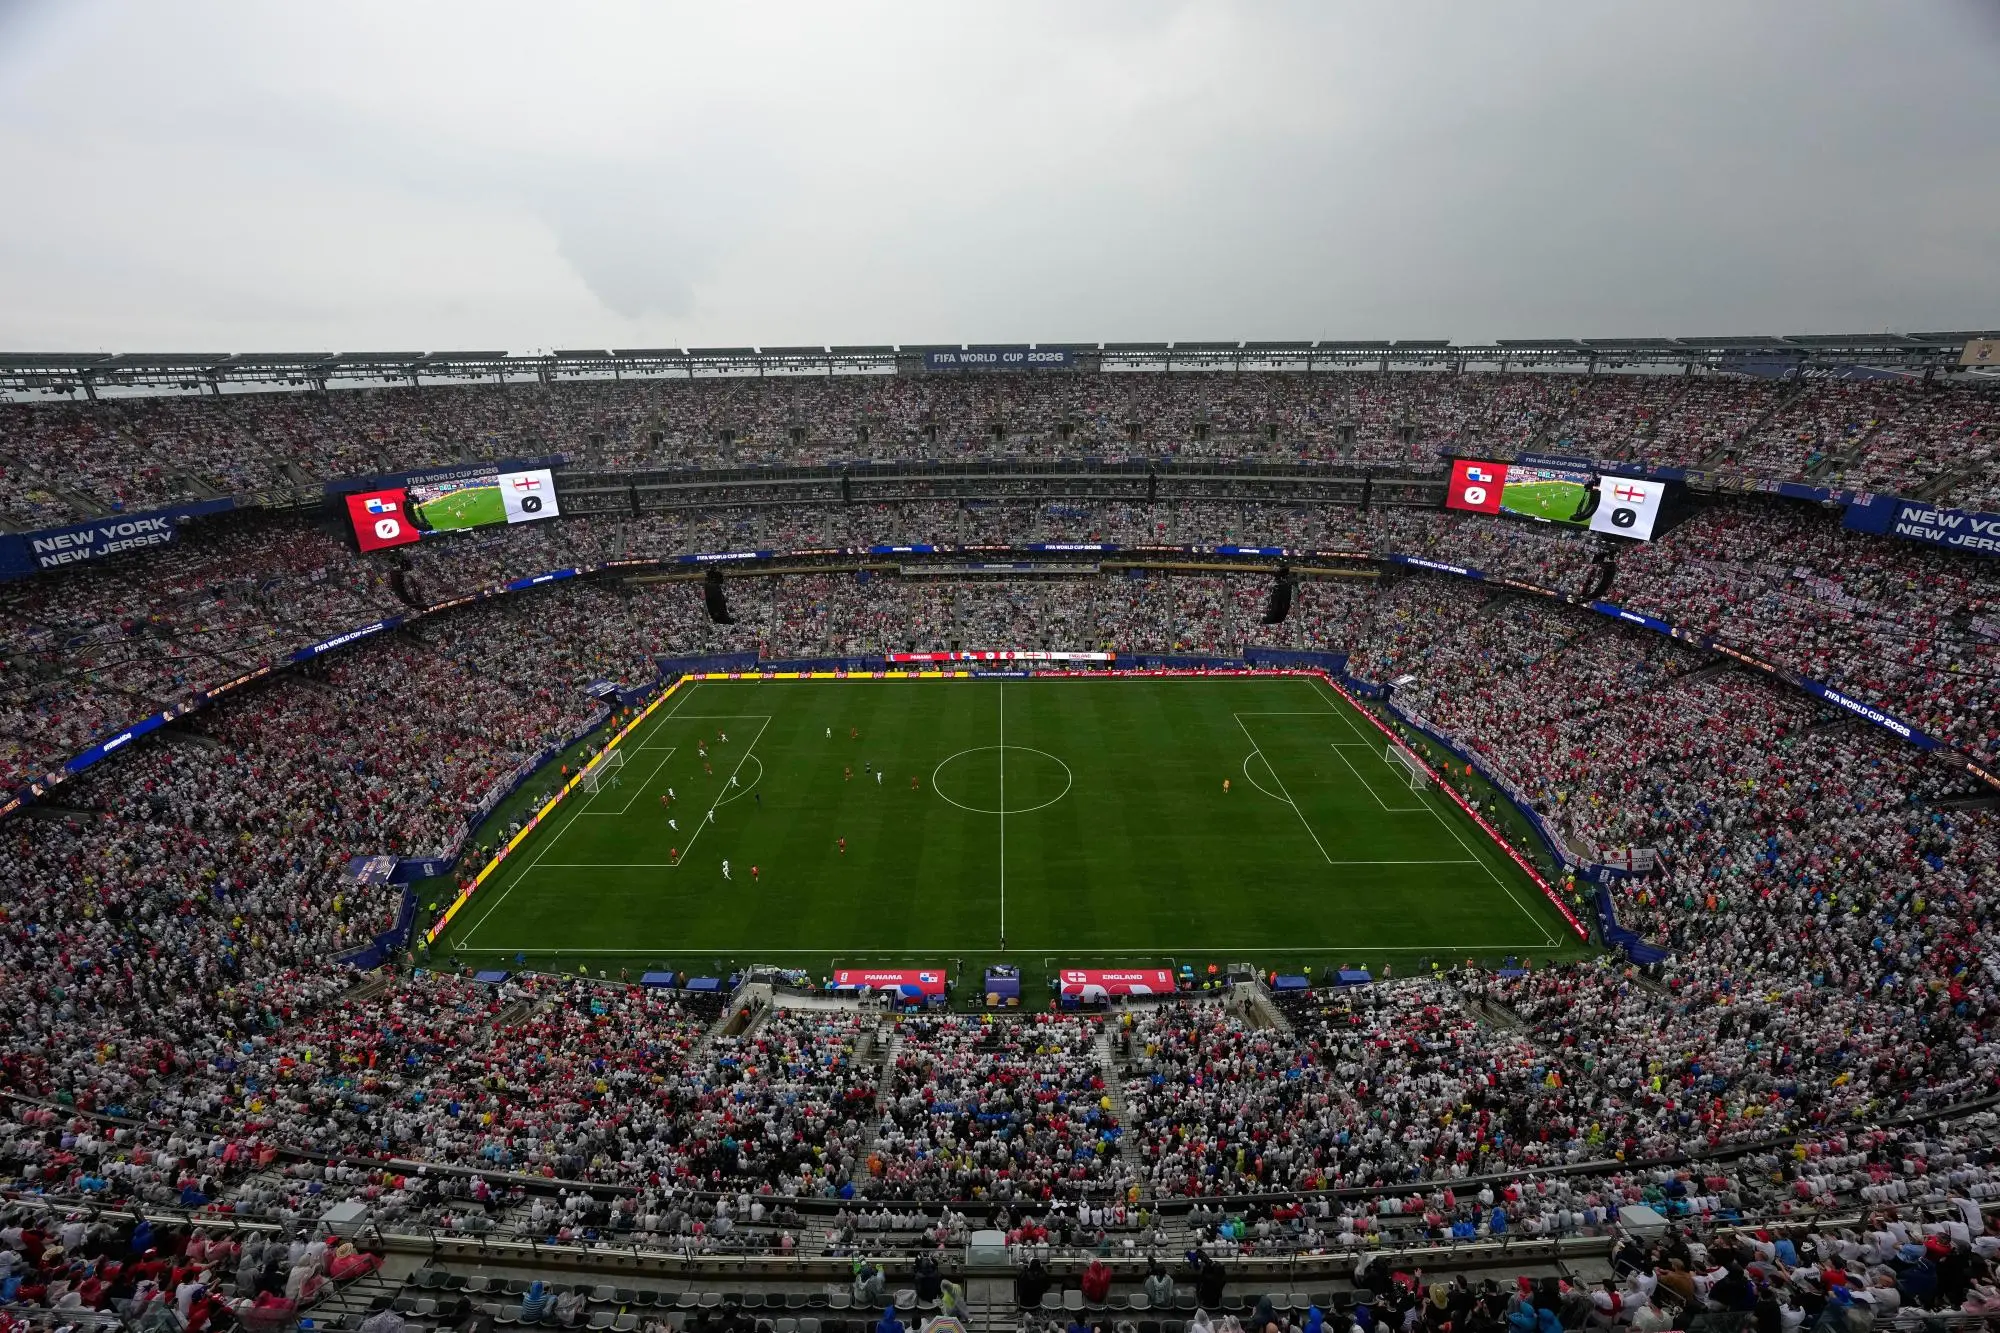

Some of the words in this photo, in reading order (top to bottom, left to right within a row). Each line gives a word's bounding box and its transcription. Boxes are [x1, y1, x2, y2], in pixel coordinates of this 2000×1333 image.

[934, 353, 956, 362] FIFA
[960, 353, 997, 362] WORLD
[1003, 353, 1023, 362] CUP
[1027, 352, 1064, 362] 2026
[406, 476, 425, 485] FIFA
[425, 473, 455, 482] WORLD
[456, 470, 472, 478] CUP
[472, 466, 498, 476] 2026
[1901, 507, 1964, 529] NEW
[32, 530, 94, 553] NEW
[99, 516, 170, 539] YORK
[1895, 522, 1946, 541] NEW
[39, 548, 90, 568] NEW
[96, 531, 172, 556] JERSEY
[1419, 560, 1438, 568] WORLD
[314, 643, 329, 653] FIFA
[328, 634, 350, 647] WORLD
[349, 631, 361, 639] CUP
[1824, 689, 1840, 703] FIFA
[1840, 696, 1868, 715] WORLD
[1867, 710, 1885, 722] CUP
[1884, 718, 1911, 737] 2026
[1509, 850, 1536, 879] Budweiser
[1547, 889, 1574, 922] Budweiser
